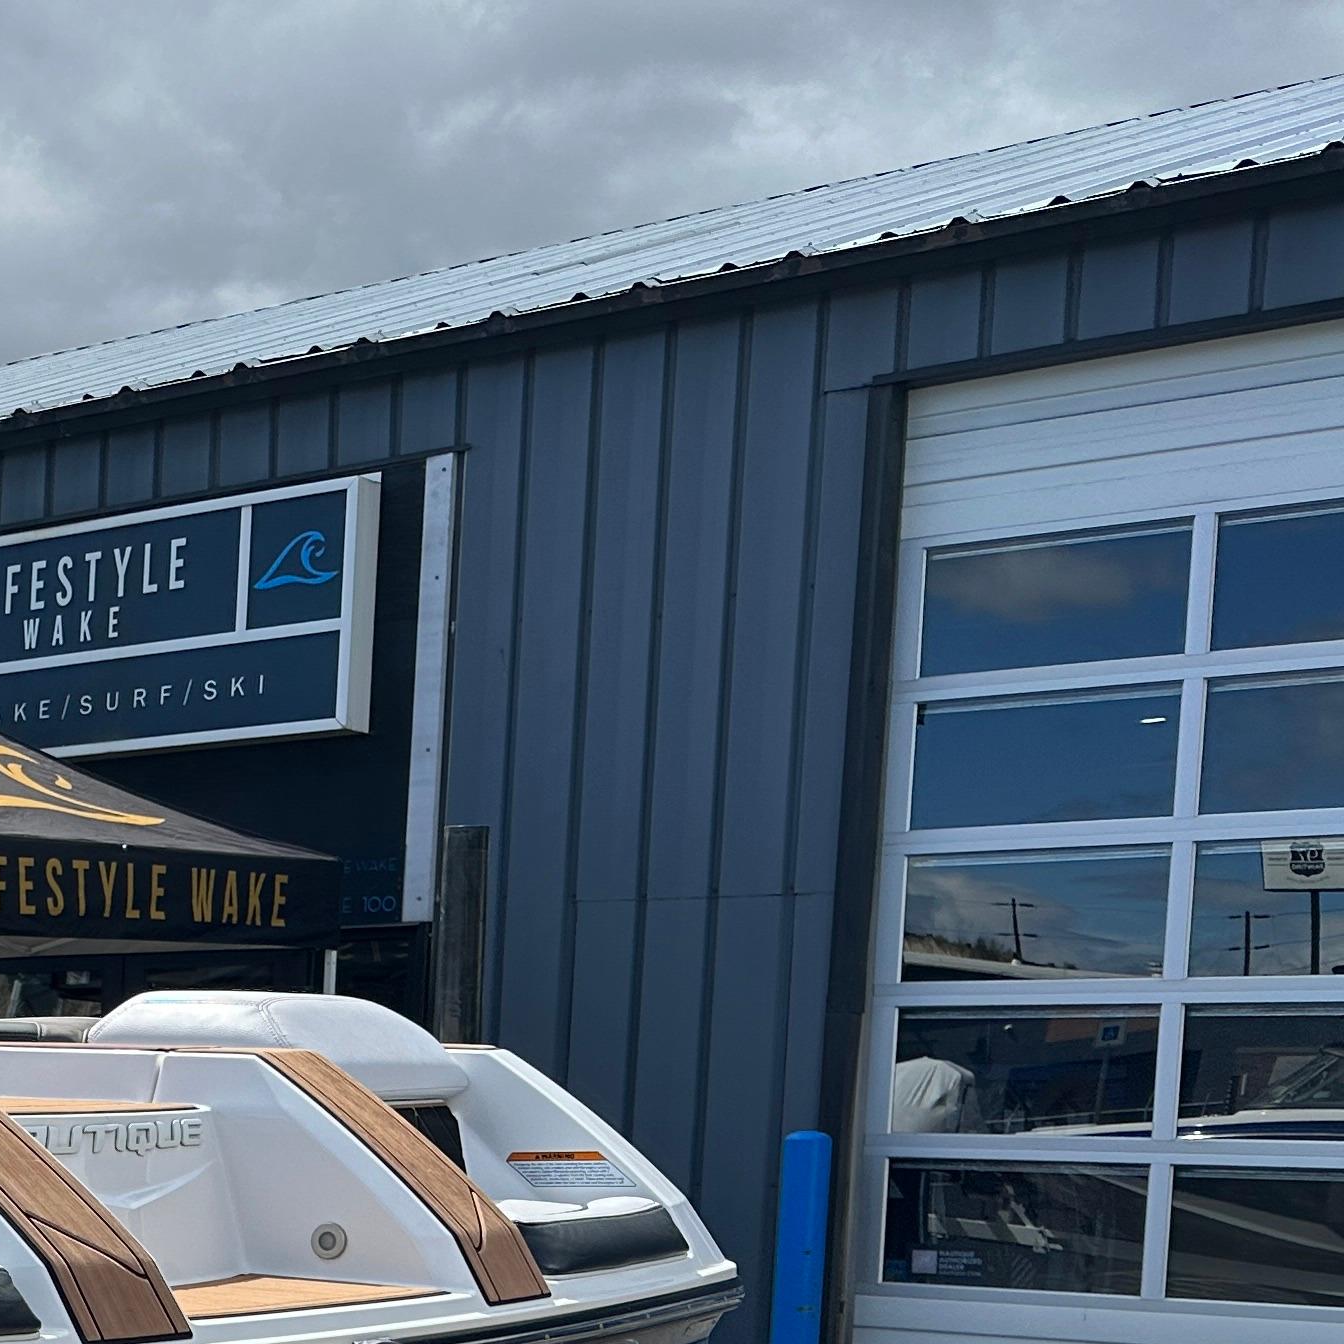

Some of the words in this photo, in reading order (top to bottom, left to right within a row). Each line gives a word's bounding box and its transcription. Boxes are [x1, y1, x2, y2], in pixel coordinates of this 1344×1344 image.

[23, 606, 120, 650] WAKE
[191, 867, 289, 927] WAKE
[362, 895, 397, 913] 100
[21, 1118, 203, 1157] AUTIQUE
